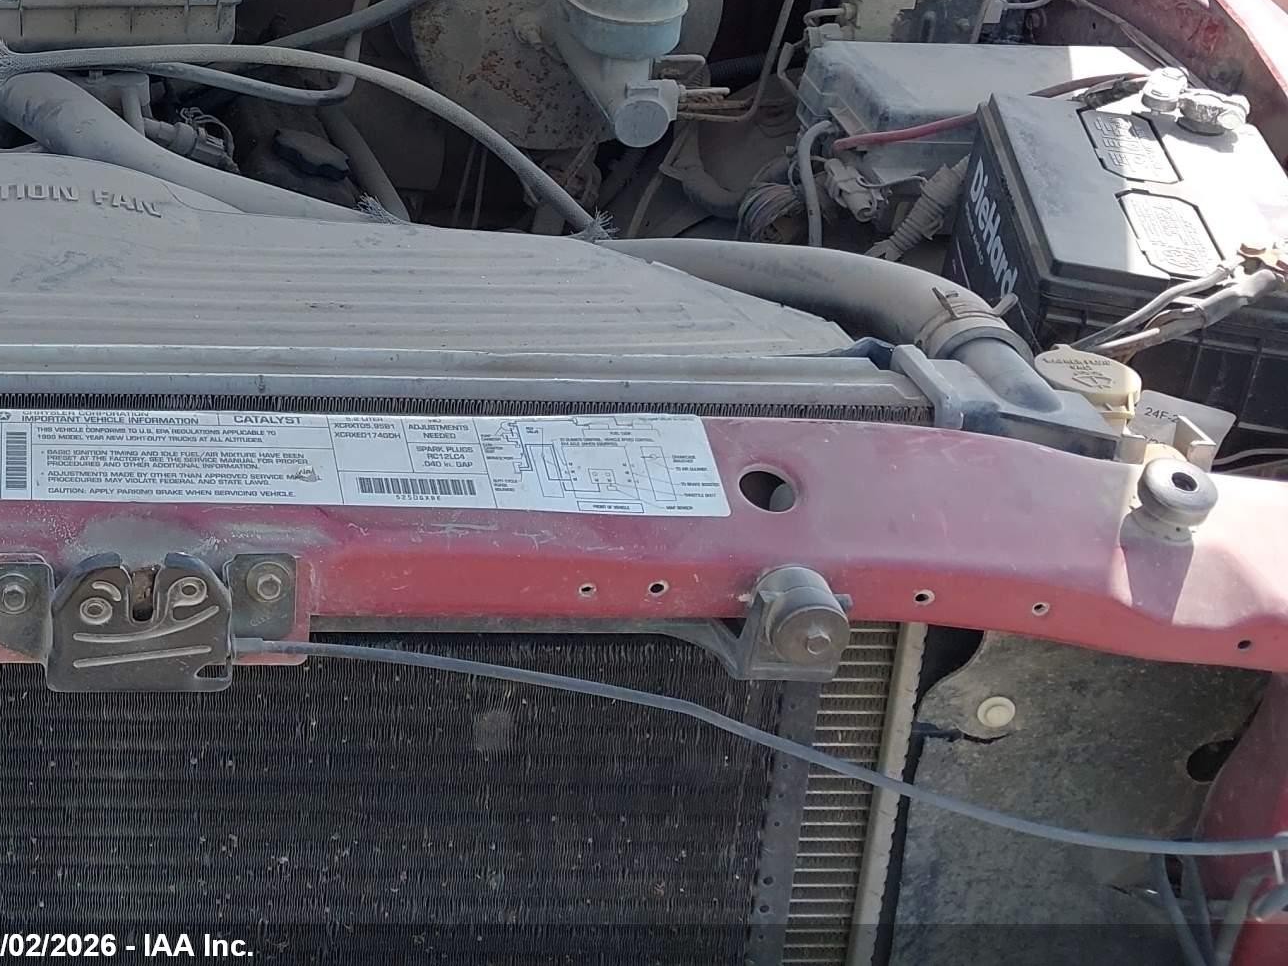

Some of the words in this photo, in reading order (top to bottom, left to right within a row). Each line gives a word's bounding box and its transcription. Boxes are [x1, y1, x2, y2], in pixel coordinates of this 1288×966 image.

[92, 187, 163, 219] FAN
[970, 155, 1019, 301] DieHard
[21, 415, 81, 423] IMPORTANT
[83, 416, 125, 424] VEHICLE
[128, 417, 199, 425] INFORMATION
[233, 415, 302, 425] CATALYST
